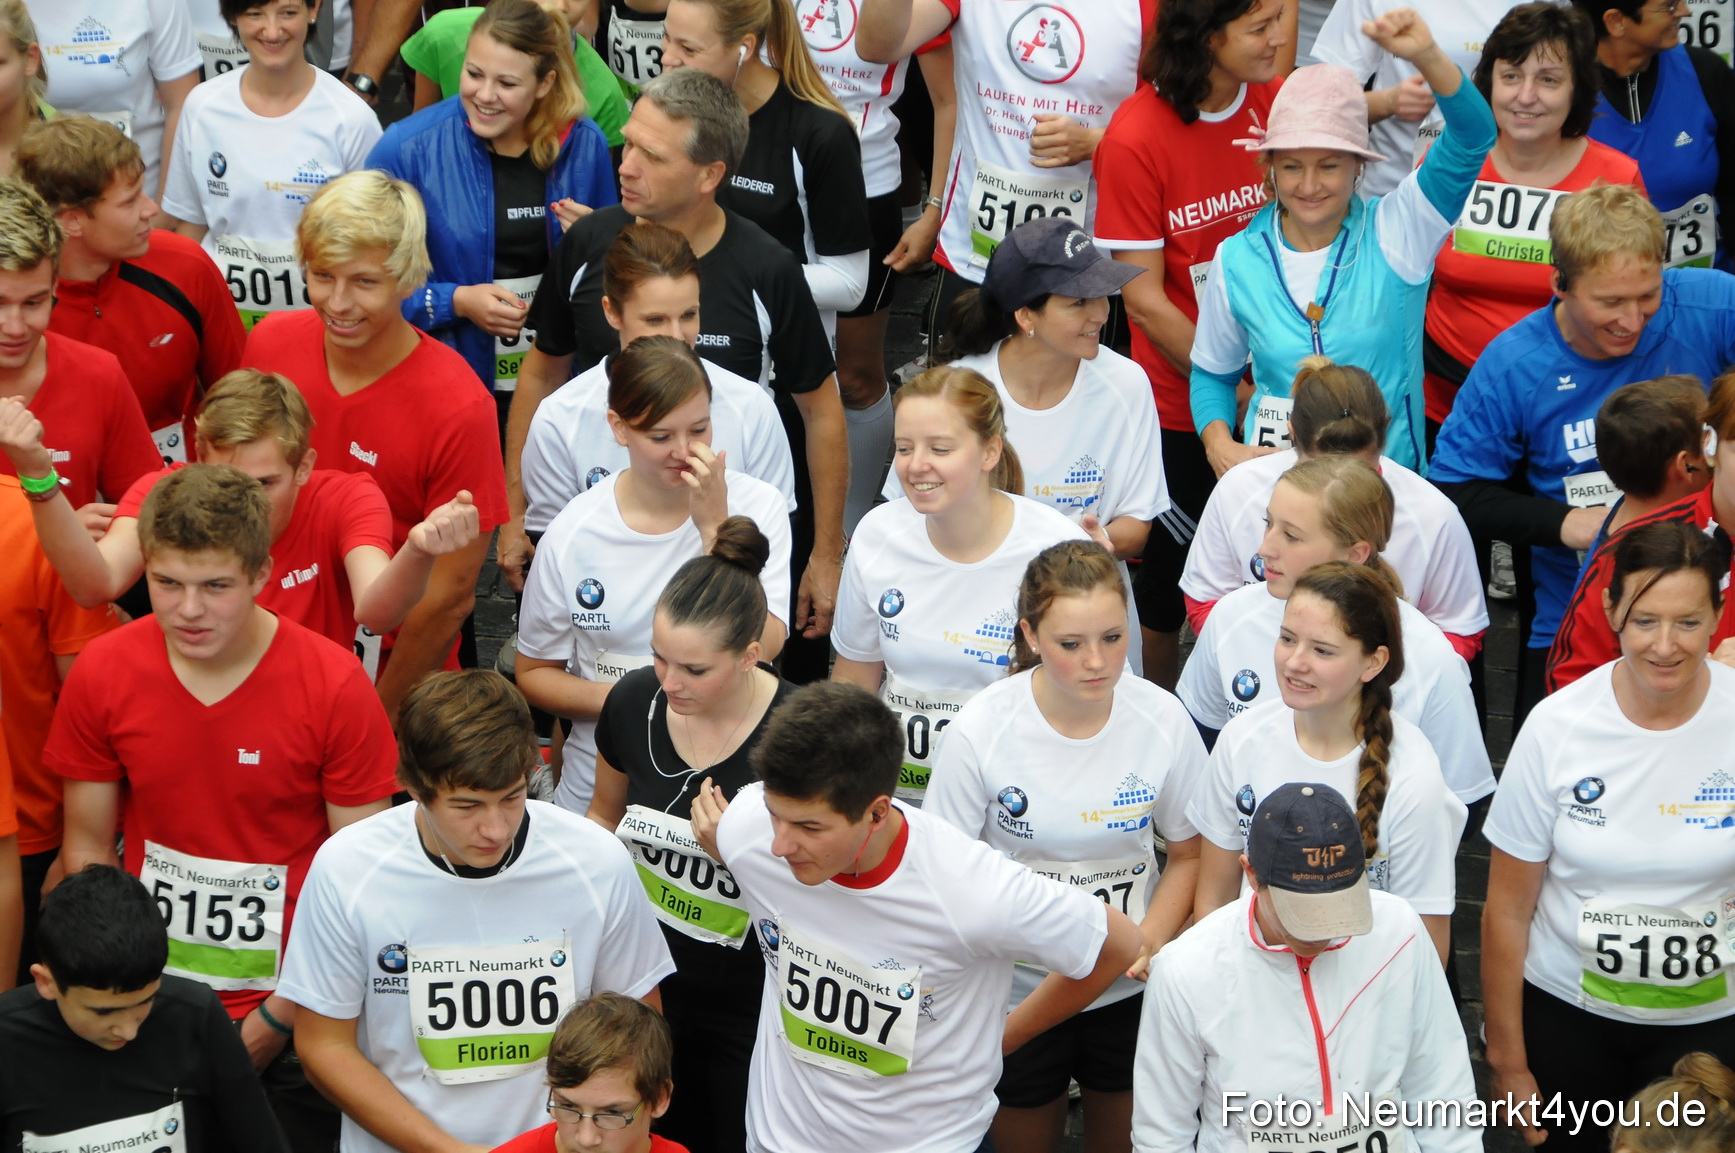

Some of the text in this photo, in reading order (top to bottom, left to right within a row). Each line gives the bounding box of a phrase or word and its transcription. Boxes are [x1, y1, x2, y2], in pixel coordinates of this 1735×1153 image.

[841, 66, 873, 79] HERZ
[831, 81, 861, 92] Röschl
[977, 82, 1104, 115] LAUFEN MIT HERZ
[985, 106, 999, 116] Dr.
[1002, 110, 1025, 123] Heck
[207, 179, 230, 191] PARTL
[731, 174, 775, 195] LEIDERER
[977, 171, 1065, 200] PARTL Neumarkt
[978, 191, 1072, 236] 51
[1470, 183, 1571, 232] 507
[217, 245, 252, 261] PARTL
[1486, 239, 1544, 263] Christa
[1033, 485, 1054, 497] 14.
[1570, 484, 1614, 499] PARTL
[571, 613, 610, 624] PARTL
[943, 631, 963, 646] 14.
[1081, 811, 1104, 824] 14.
[1567, 811, 1606, 827] Neumarkt
[1570, 804, 1607, 819] PARTL
[1658, 803, 1682, 816] 14.
[623, 817, 662, 840] PARTL
[998, 810, 1033, 832] PARTL
[998, 820, 1033, 840] Neumarkt
[146, 855, 257, 889] PARTL Neumarkt
[1069, 868, 1128, 886] Neumarkt
[1292, 872, 1324, 882] lightning
[153, 879, 266, 942] 5153
[660, 885, 702, 921] Tanja
[1583, 911, 1633, 926] PARTL
[411, 957, 544, 973] PARTL Neumarkt
[781, 934, 822, 967] PARTL
[826, 958, 891, 997] Neumarkt
[1596, 933, 1722, 980] 5188
[427, 975, 559, 1031] 5006
[786, 961, 902, 1046] 5007
[458, 1041, 530, 1063] Florian
[805, 1028, 868, 1063] Tobias
[79, 1129, 158, 1153] Neumarkt
[1251, 1131, 1305, 1143] PARTL
